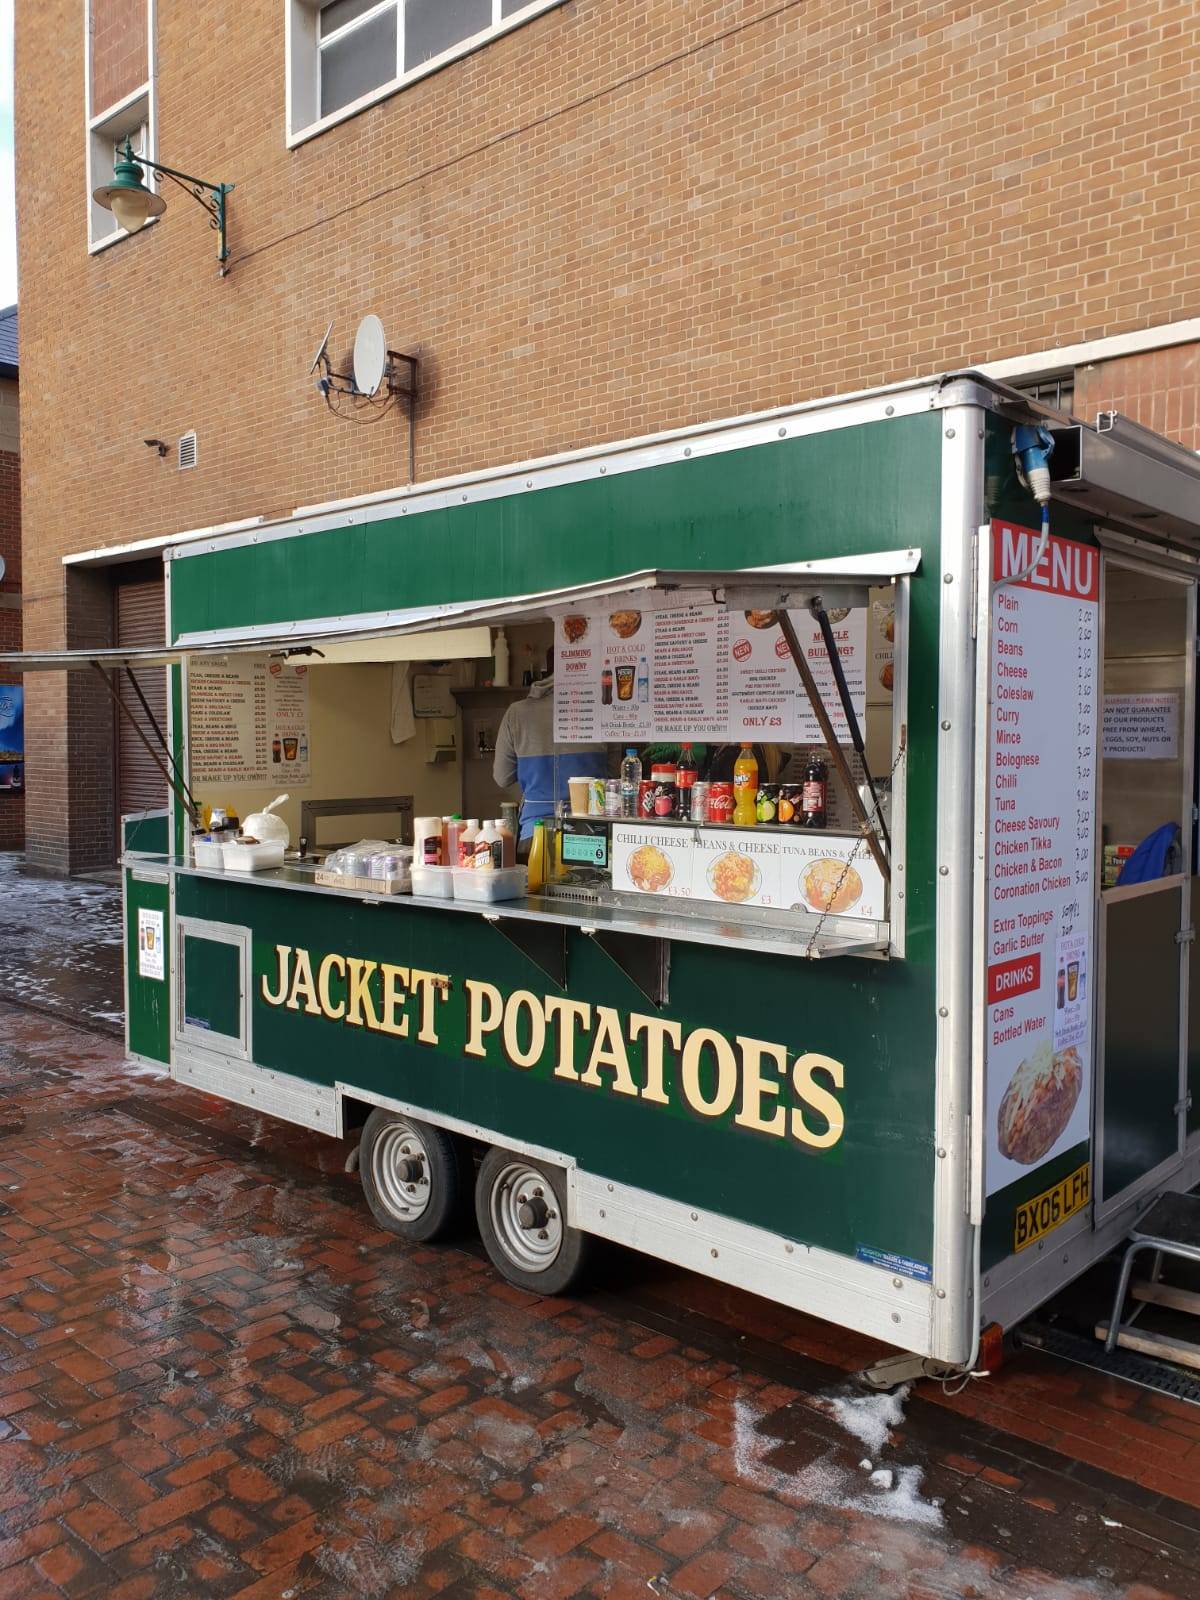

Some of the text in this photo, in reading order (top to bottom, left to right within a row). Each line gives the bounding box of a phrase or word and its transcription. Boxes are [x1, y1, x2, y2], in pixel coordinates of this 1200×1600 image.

[1002, 528, 1092, 595] MENU
[998, 593, 1019, 612] Plain
[998, 617, 1018, 633] Corn
[560, 649, 592, 659] SLIMMING
[606, 646, 621, 654] HOT
[627, 644, 646, 654] COLD
[997, 640, 1024, 657] Beans
[614, 655, 638, 663] DRINKS
[997, 662, 1028, 679] Cheese
[997, 684, 1034, 701] Coleslaw
[996, 707, 1020, 726] Curry
[1116, 706, 1130, 714] NOT
[655, 724, 664, 733] OR
[665, 724, 684, 732] MAKE
[684, 724, 693, 732] UP
[693, 723, 706, 732] YOU
[742, 716, 782, 727] ONLY £3
[996, 730, 1022, 745] Mince
[995, 752, 1041, 770] Bolognese
[192, 774, 201, 782] OR
[202, 774, 221, 782] MAKE
[223, 774, 232, 782] UP
[233, 773, 247, 782] YOU
[995, 774, 1018, 789] Chilli
[995, 797, 1016, 811] Tuna
[995, 815, 1061, 834] Cheese Savoury
[617, 833, 648, 846] CHILLI
[650, 835, 690, 849] CHEESE
[697, 838, 780, 855] BEANS & CHEESE
[994, 836, 1052, 856] Chicken Tikka
[782, 845, 806, 856] TUNA
[808, 847, 837, 858] BEANS
[994, 857, 1062, 879] Chicken & Bacon
[994, 875, 1071, 901] Coronation Chicken
[761, 895, 772, 905] £3
[861, 905, 873, 917] £4
[993, 910, 1054, 934] Extra Toppings
[993, 937, 1018, 956] Garlic
[1020, 932, 1045, 949] Butter
[996, 964, 1034, 992] DRINKS
[993, 1007, 1014, 1024] Cans
[993, 1023, 1023, 1046] Bottled
[1024, 1016, 1046, 1033] Water
[262, 944, 844, 1149] JACKET POTATOES
[1017, 1167, 1089, 1245] BX06 LFH
